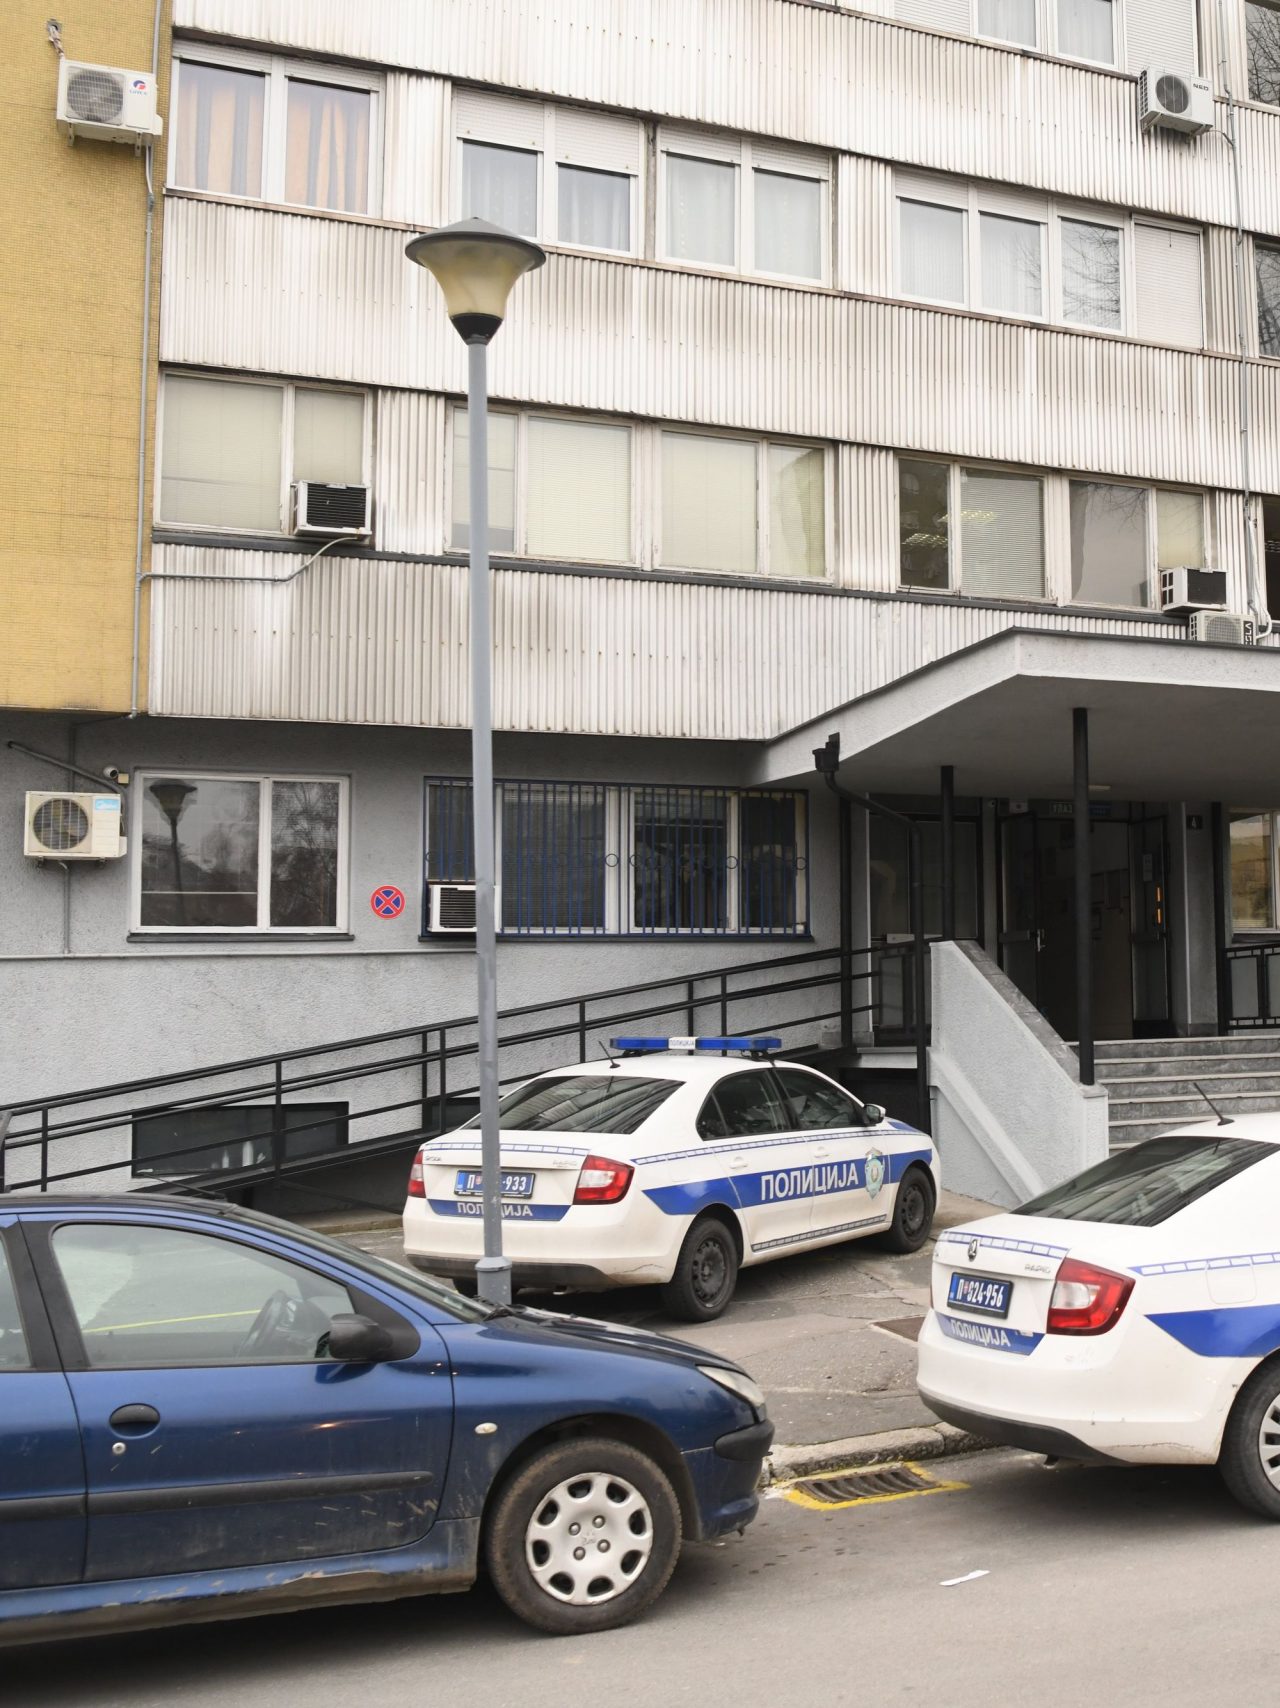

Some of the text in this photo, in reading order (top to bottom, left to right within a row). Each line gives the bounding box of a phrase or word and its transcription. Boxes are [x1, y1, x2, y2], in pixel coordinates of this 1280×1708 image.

[1244, 622, 1253, 646] SLA
[761, 1162, 859, 1201] ПОЛИЦИЈА
[456, 1202, 533, 1219] ПОЛИЈА
[949, 1318, 1012, 1348] ПОЛИЦИЈА
